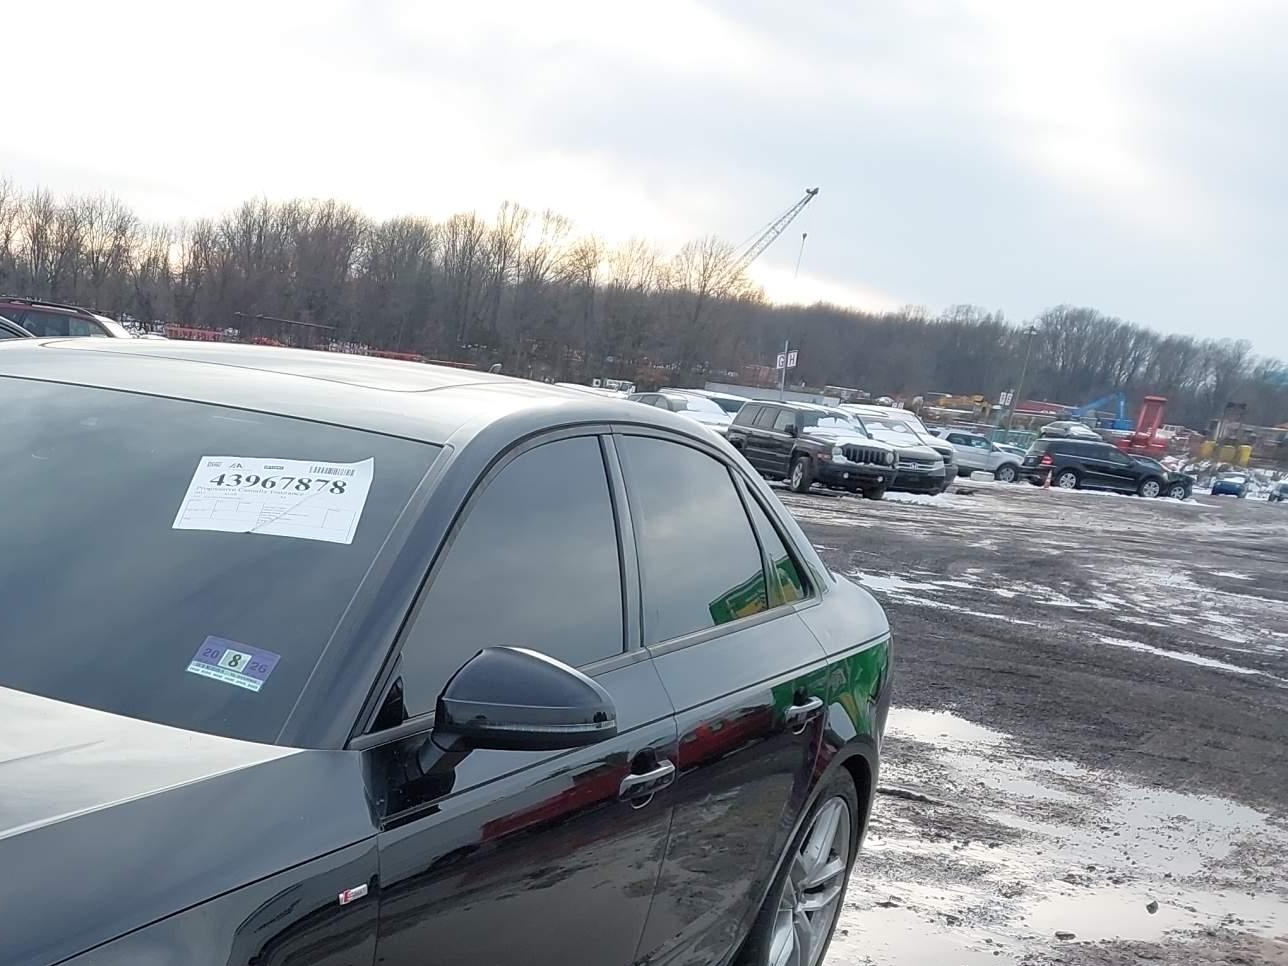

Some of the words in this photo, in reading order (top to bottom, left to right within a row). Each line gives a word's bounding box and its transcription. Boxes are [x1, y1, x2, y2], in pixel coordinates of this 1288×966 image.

[788, 352, 796, 366] H
[210, 473, 347, 495] 43967878
[202, 647, 220, 659] 20
[228, 654, 242, 668] 8
[249, 661, 269, 674] 26
